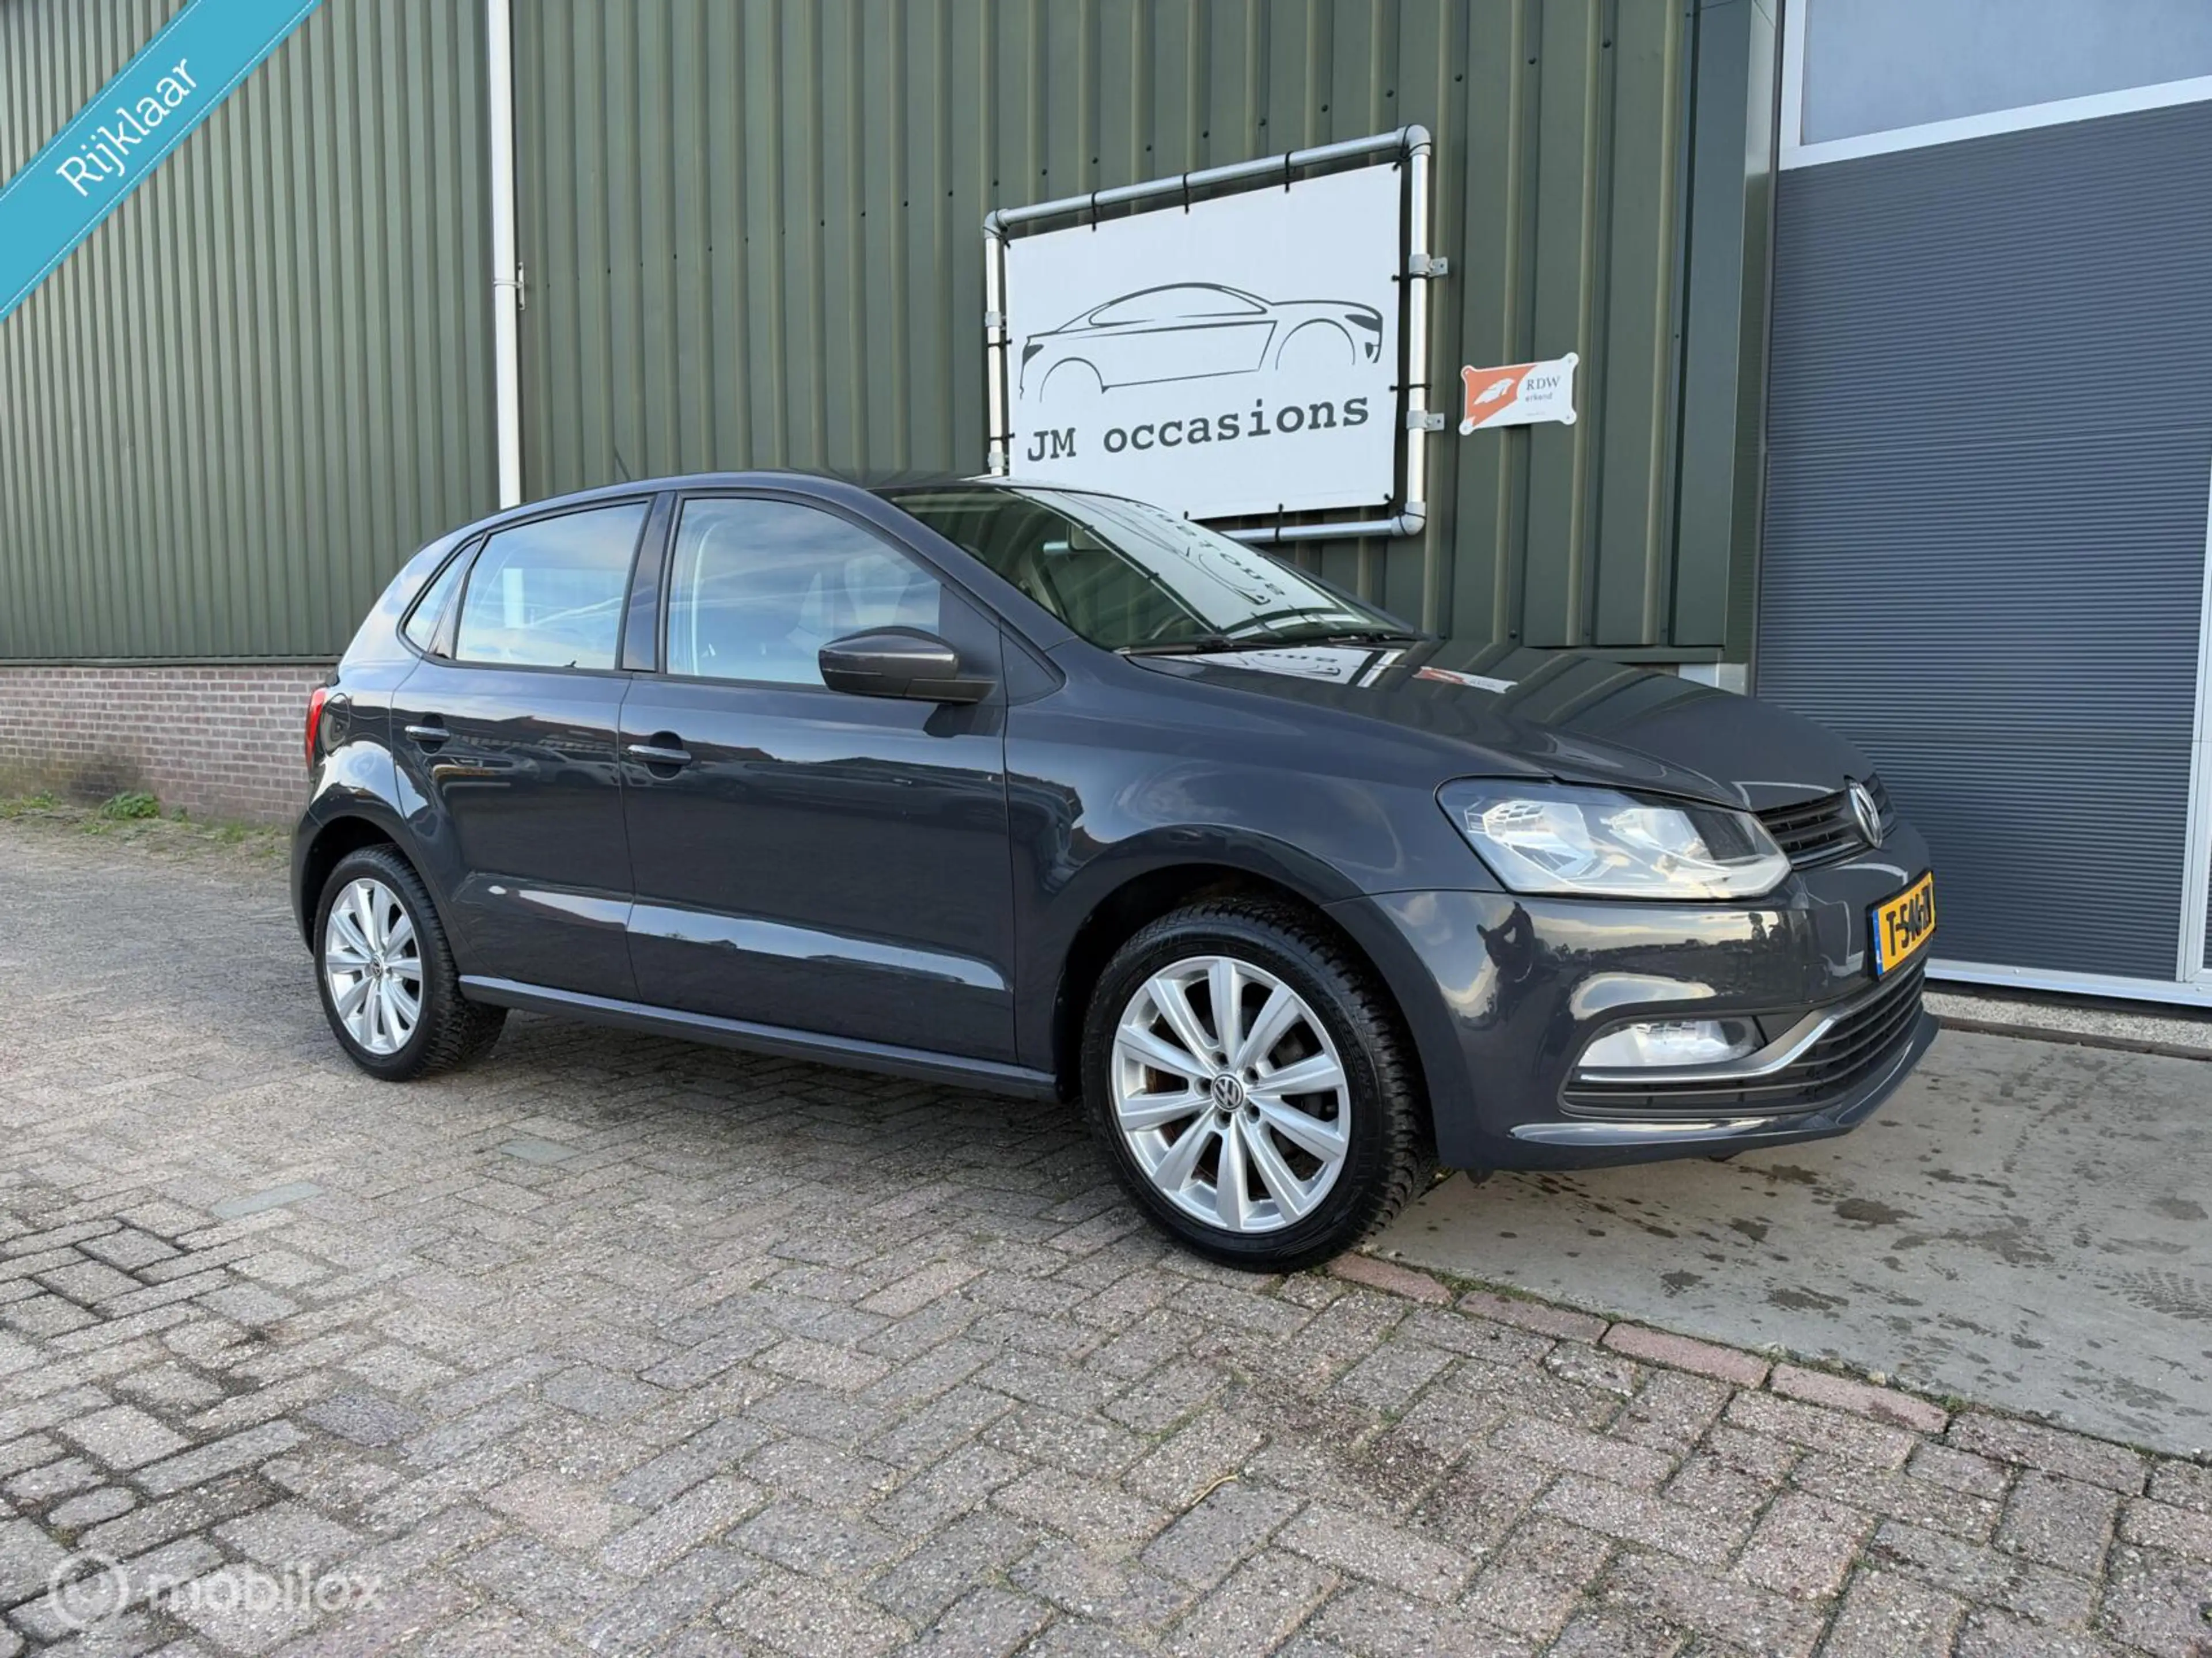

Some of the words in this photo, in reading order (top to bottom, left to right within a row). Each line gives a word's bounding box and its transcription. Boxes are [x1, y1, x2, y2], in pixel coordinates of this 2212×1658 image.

[1527, 375, 1560, 390] RDW
[1028, 427, 1076, 461] JM
[1103, 397, 1368, 453] occasions
